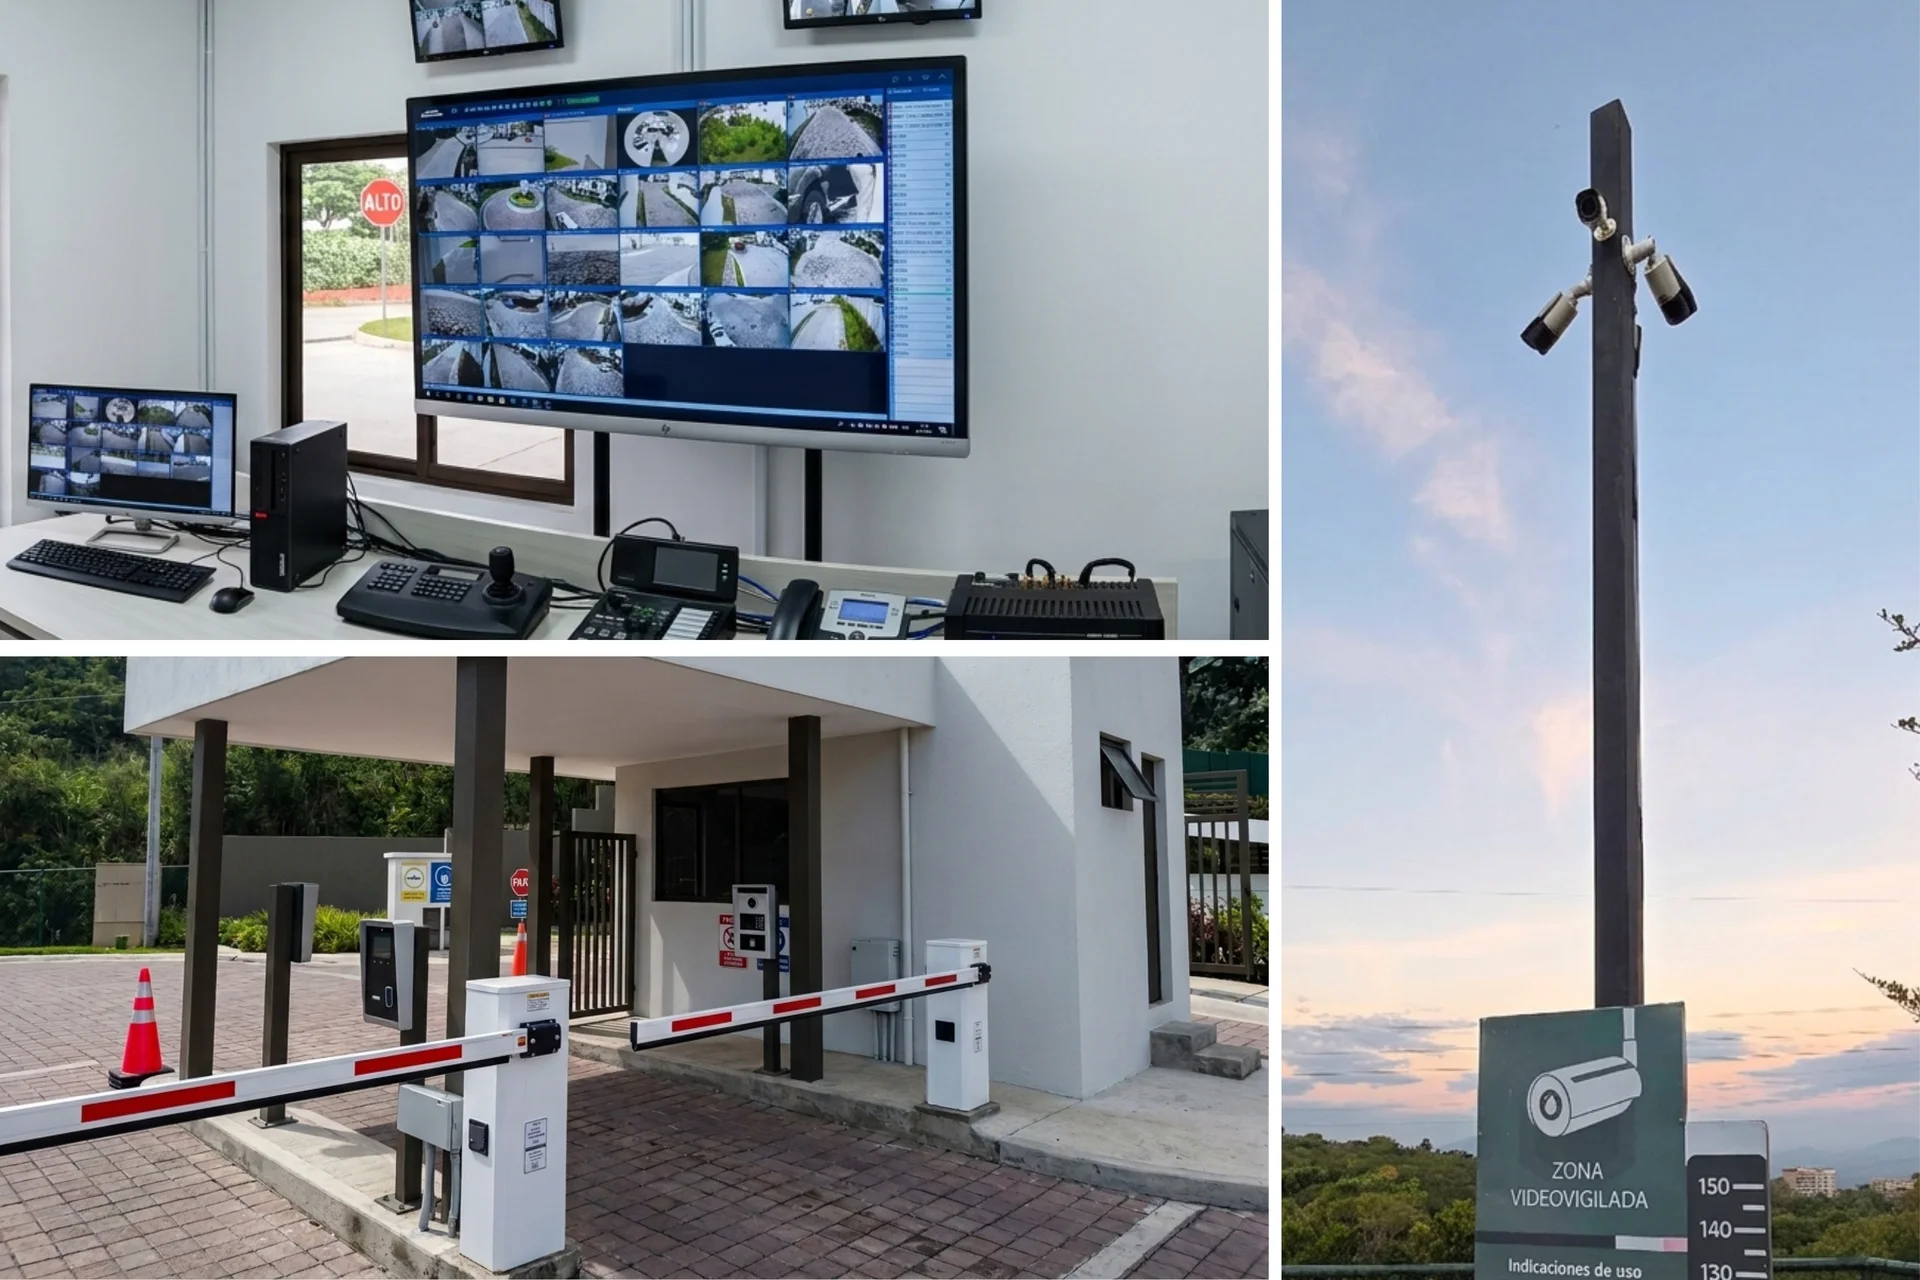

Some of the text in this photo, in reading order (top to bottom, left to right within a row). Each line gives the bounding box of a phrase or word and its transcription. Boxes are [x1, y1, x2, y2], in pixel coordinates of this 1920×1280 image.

[364, 192, 402, 212] ALTO
[512, 877, 528, 887] PAR
[1551, 1161, 1604, 1180] ZONA
[1698, 1177, 1730, 1195] 150
[1510, 1188, 1649, 1209] VIDEOVIGILADA
[1699, 1220, 1732, 1238] 140
[1508, 1257, 1642, 1279] Indicaciones de uso
[1700, 1263, 1732, 1280] 130
